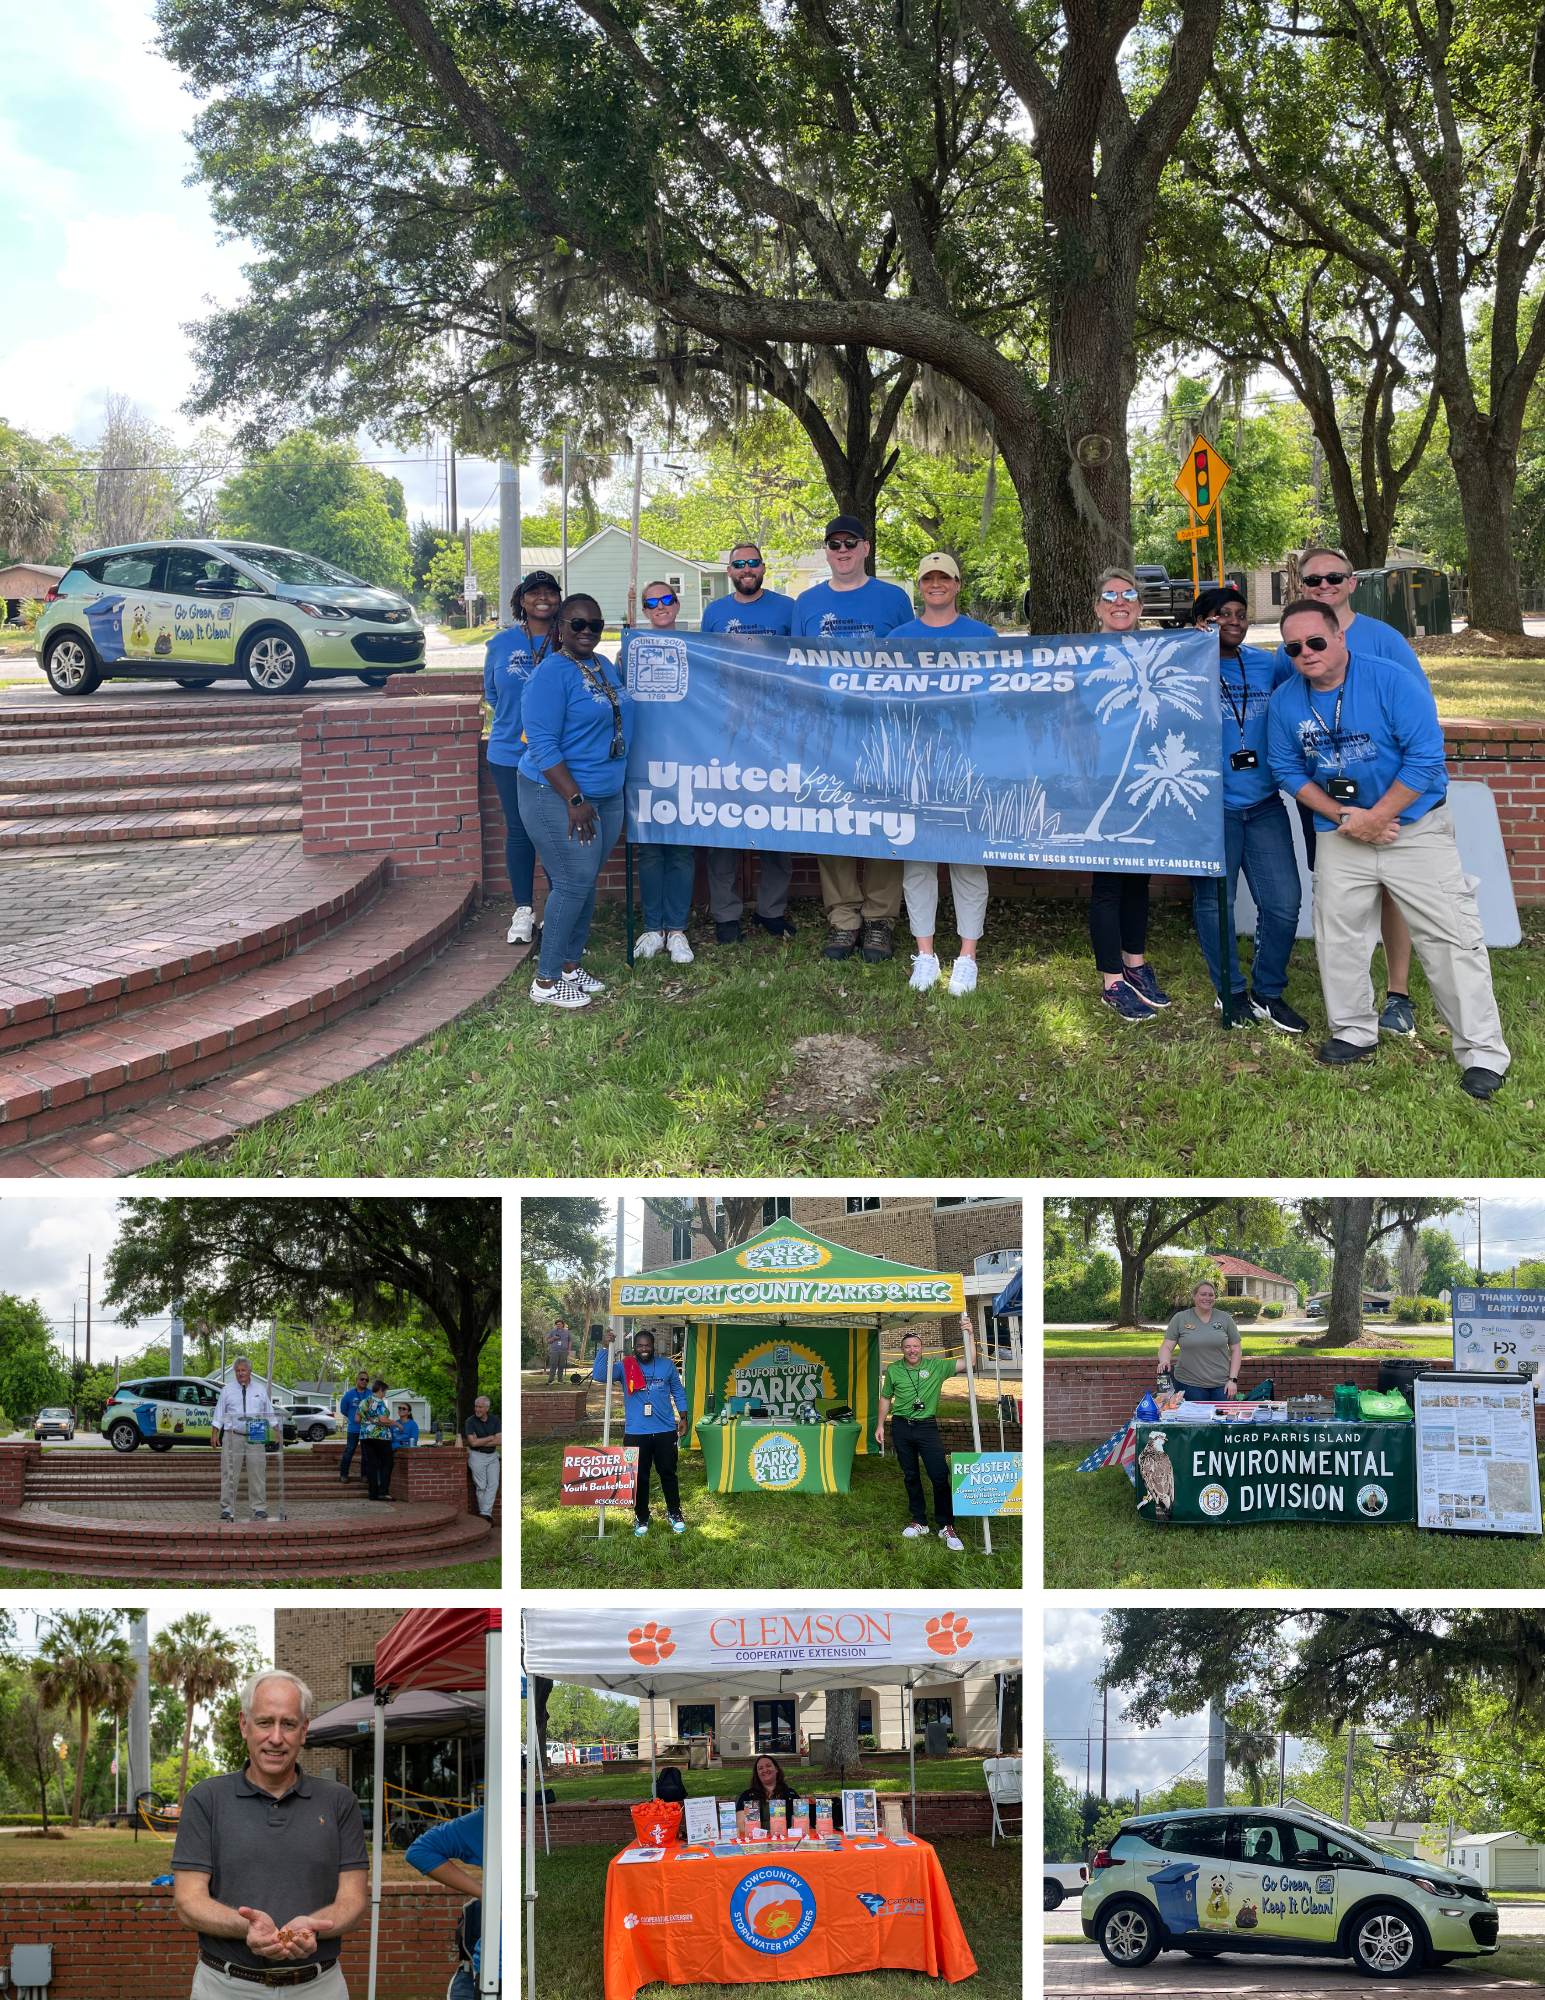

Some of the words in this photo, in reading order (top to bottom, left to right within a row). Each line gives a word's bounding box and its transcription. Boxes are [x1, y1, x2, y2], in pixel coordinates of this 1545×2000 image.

[174, 604, 188, 620] Go
[188, 604, 214, 620] Green,
[174, 624, 194, 645] Keep
[196, 623, 204, 640] It
[206, 622, 232, 640] Clean!
[630, 638, 660, 650] COUNTY
[664, 639, 686, 654] SOUTH
[786, 648, 912, 668] ANNUAL
[919, 649, 1022, 668] EARTH
[1032, 646, 1098, 667] DAY
[628, 653, 636, 696] BEAUFORT
[678, 656, 688, 696] CAROLINA
[829, 672, 983, 692] CLEAN-UP
[988, 671, 1075, 692] 2025
[794, 766, 842, 803] for
[818, 782, 856, 804] the
[638, 790, 916, 845] lowcountry
[982, 850, 1026, 861] ARTWORK
[1028, 853, 1040, 862] BY
[1042, 854, 1066, 863] USCB
[1068, 856, 1110, 866] STUDENT
[1112, 858, 1144, 866] SYNNE
[1147, 858, 1220, 870] BYE-ANDERSEN
[746, 1247, 814, 1260] PARKS
[746, 1260, 764, 1268] &
[770, 1256, 814, 1266] REC
[621, 1284, 724, 1304] BEAUFORT
[727, 1283, 812, 1303] COUNTY
[818, 1282, 882, 1302] PARKS
[883, 1283, 908, 1300] &
[906, 1282, 952, 1302] REC
[1480, 1294, 1513, 1302] THANK
[1488, 1304, 1518, 1312] EARTH
[1494, 1342, 1516, 1354] HDR
[734, 1366, 778, 1378] BEAUFORT
[782, 1364, 818, 1376] COUNTY
[737, 1374, 818, 1404] PARKS
[186, 1408, 193, 1416] Go
[186, 1418, 196, 1428] Keep
[198, 1418, 202, 1426] It
[1224, 1434, 1259, 1444] MCRD
[1264, 1432, 1310, 1442] PARRIS
[1314, 1433, 1361, 1442] ISLAND
[564, 1454, 621, 1468] REGISTER
[754, 1450, 797, 1468] PARKS
[954, 1461, 1011, 1474] REGISTER
[1192, 1450, 1394, 1478] ENVIRONMENTAL
[579, 1466, 626, 1478] NOW!!!
[755, 1467, 766, 1482] &
[770, 1464, 796, 1480] REC
[970, 1472, 1018, 1486] NOW!!!
[564, 1482, 588, 1492] Youth
[590, 1480, 634, 1491] Basketball
[1240, 1482, 1344, 1512] DIVISION
[710, 1613, 892, 1648] CLEMSON
[736, 1650, 804, 1660] COOPERATIVE
[808, 1648, 866, 1658] EXTENSION
[741, 1870, 802, 1892] LOWCOUNTRY
[1262, 1874, 1278, 1892] Go
[1280, 1875, 1312, 1894] Green,
[888, 1896, 924, 1906] Carolina
[1262, 1896, 1286, 1920] Keep
[1288, 1896, 1298, 1914] It
[1300, 1896, 1334, 1914] Clean!
[876, 1904, 925, 1916] CLEAR
[734, 1912, 782, 1950] STORMWATER
[782, 1910, 813, 1948] PARTNERS
